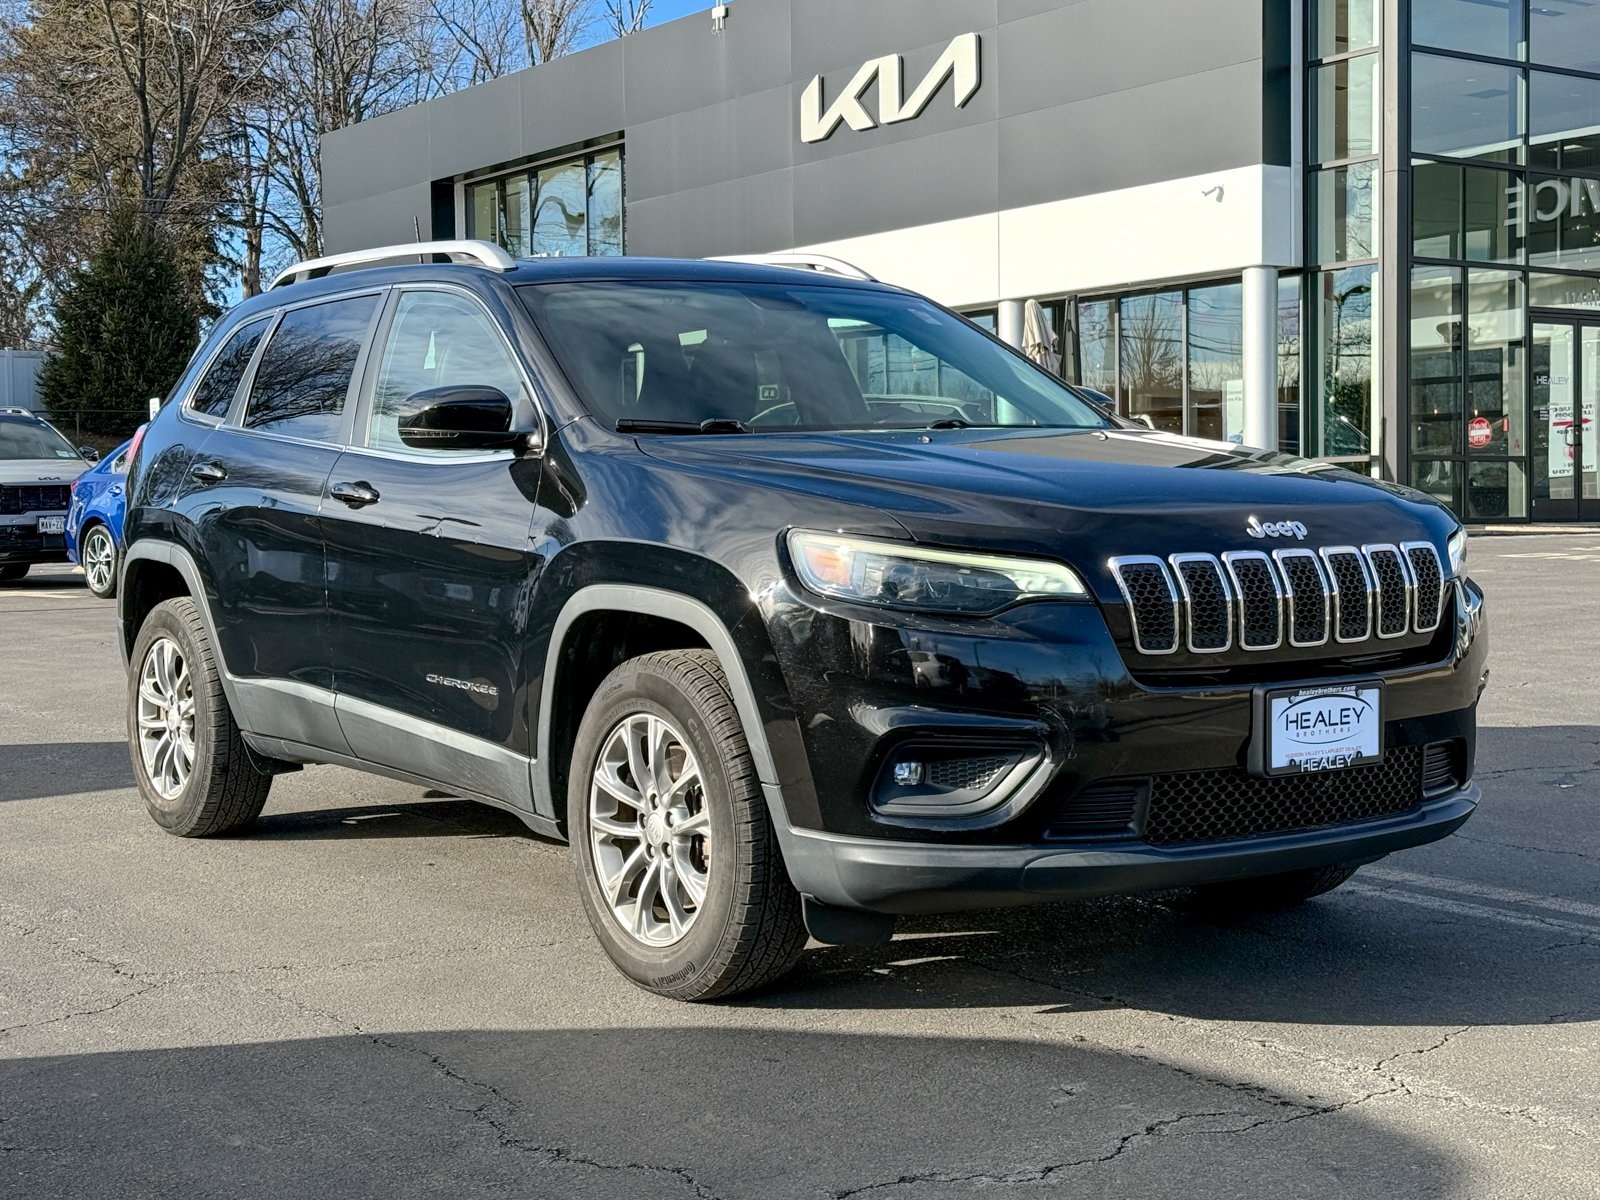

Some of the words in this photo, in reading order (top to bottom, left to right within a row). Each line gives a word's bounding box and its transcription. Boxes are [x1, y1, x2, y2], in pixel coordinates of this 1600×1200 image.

[800, 32, 982, 143] KIA
[1536, 375, 1569, 385] HEALEY
[40, 520, 64, 530] MAV-22
[1246, 515, 1308, 541] Jeep
[425, 673, 500, 696] CHEROKEE
[1285, 706, 1365, 731] HEALEY
[1296, 727, 1351, 738] BROTHERS
[1285, 751, 1303, 759] HUDSON
[1304, 748, 1325, 757] VALLEY'S
[1325, 747, 1344, 755] LARGEST
[1301, 754, 1353, 773] HEALEY
[657, 960, 697, 988] Continental
